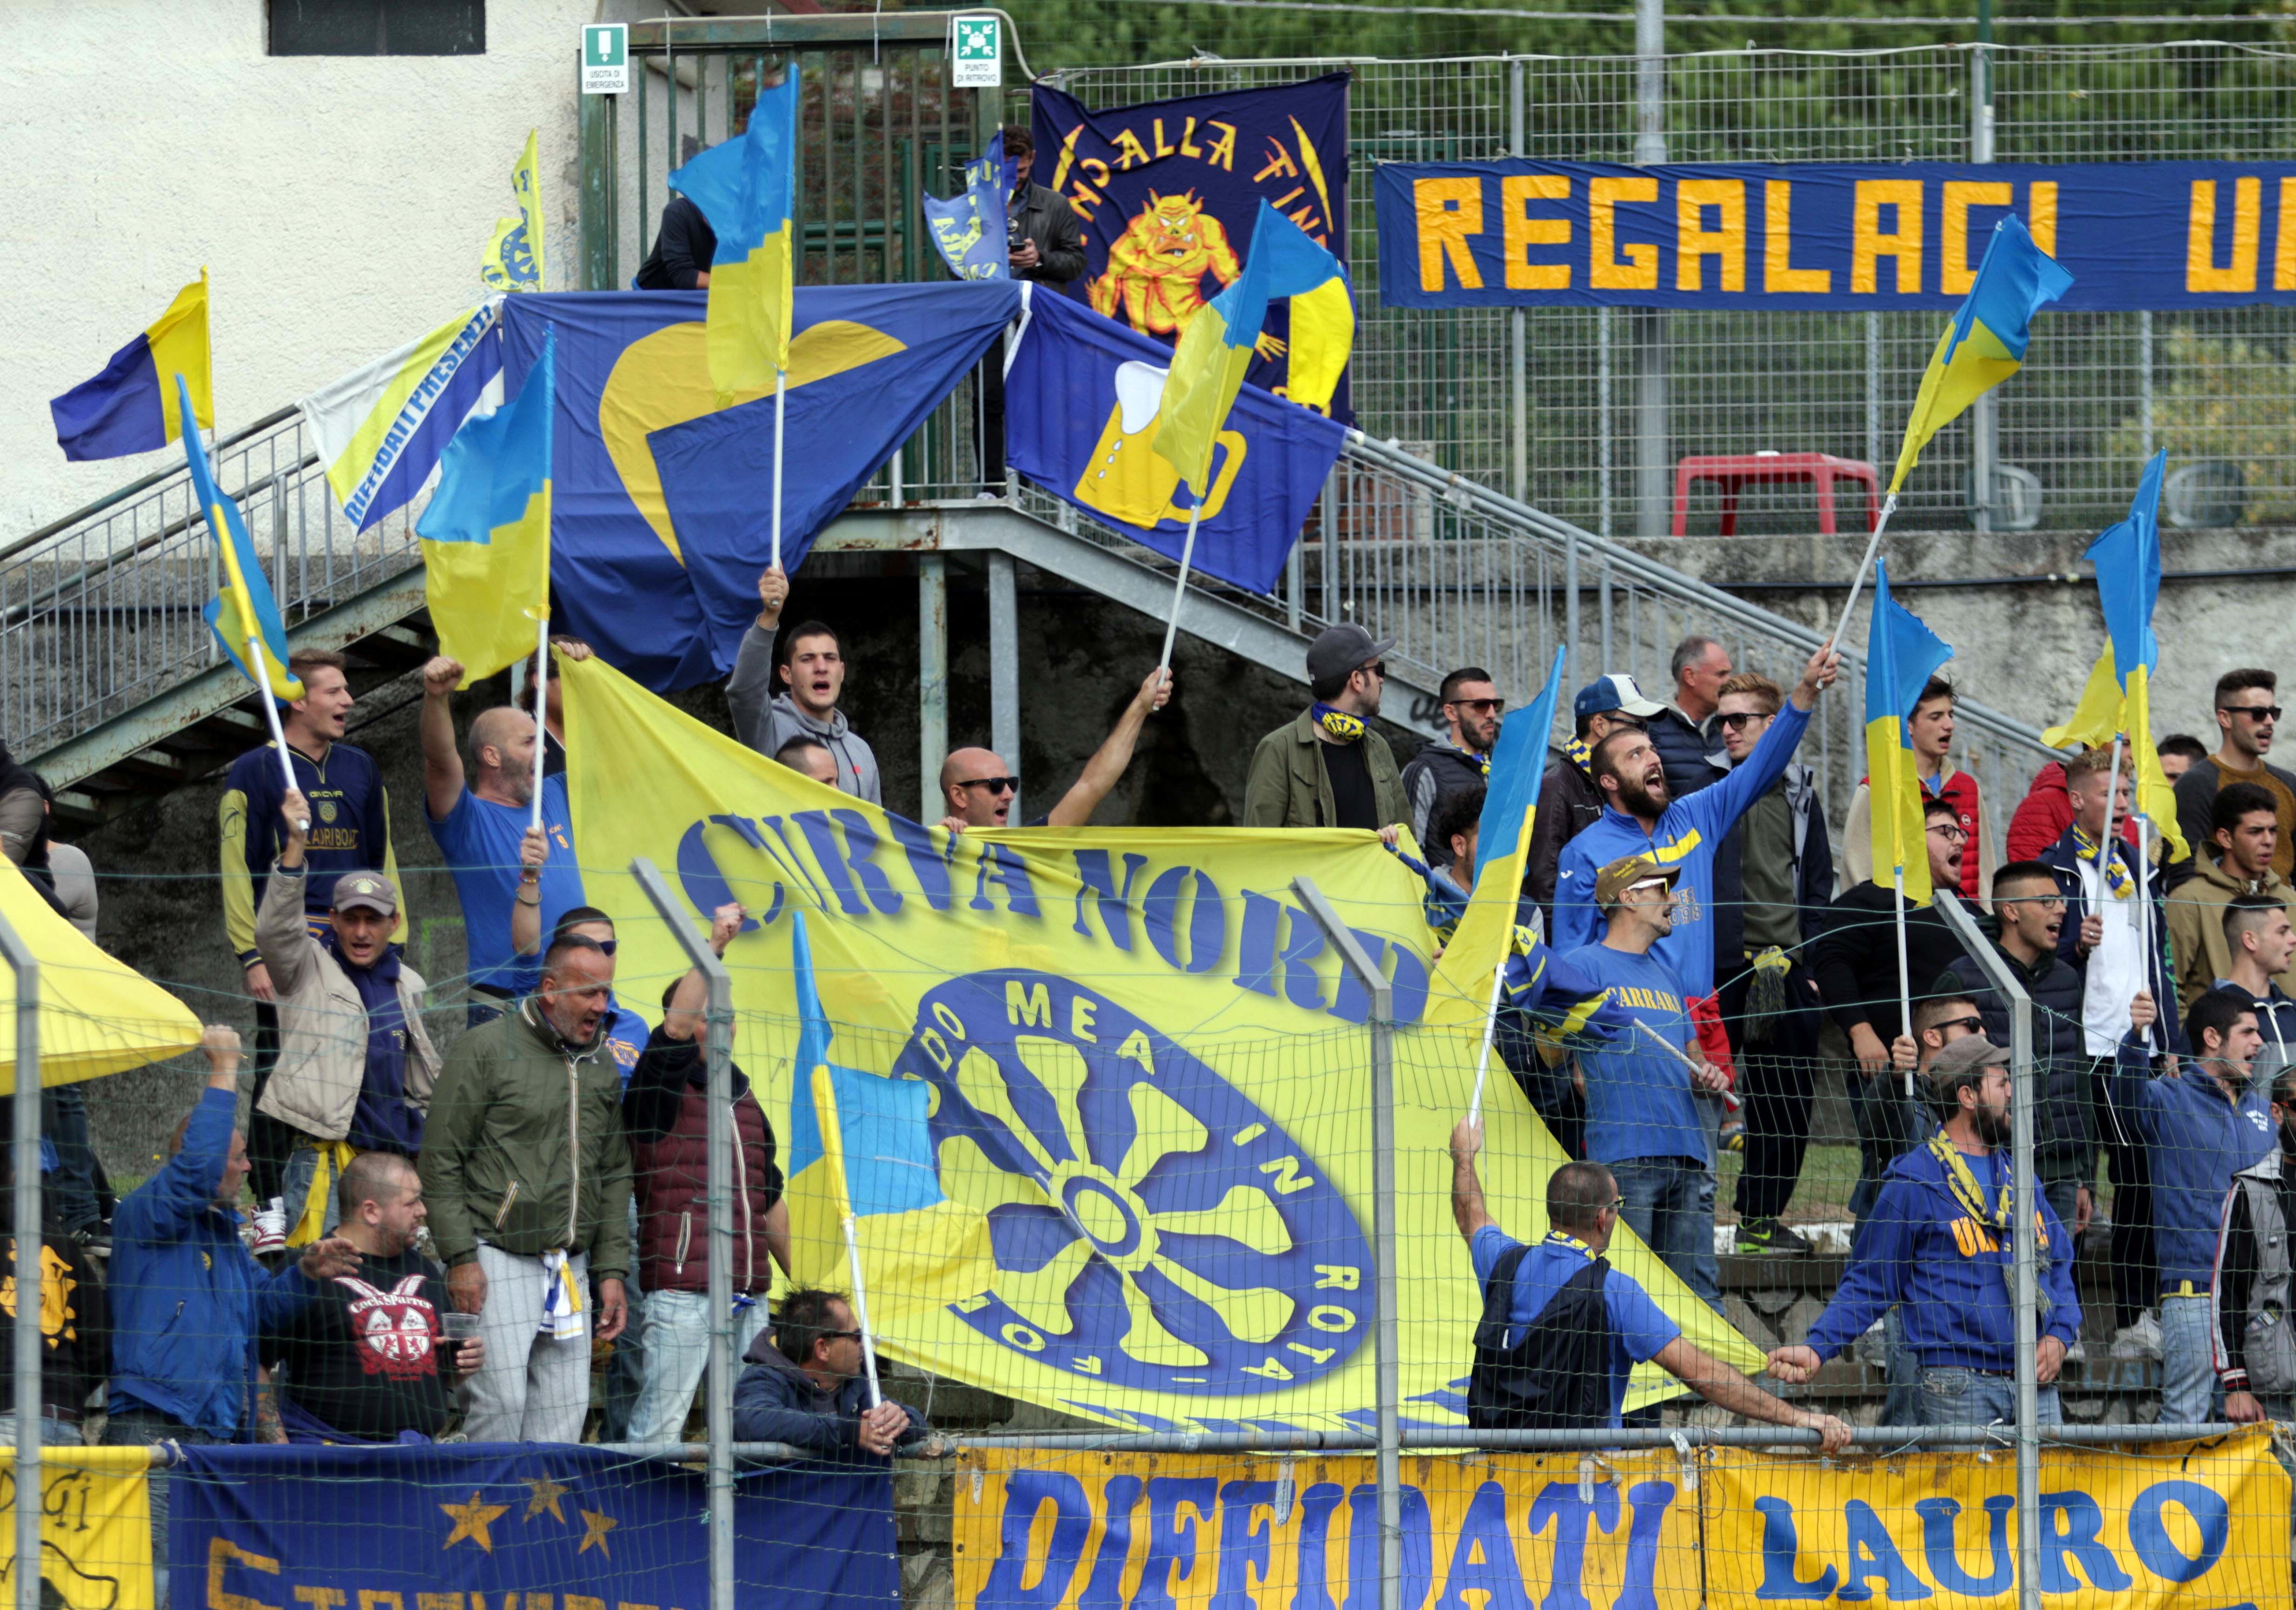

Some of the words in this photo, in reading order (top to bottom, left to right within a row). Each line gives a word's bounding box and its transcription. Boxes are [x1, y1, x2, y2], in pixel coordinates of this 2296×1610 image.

[1110, 116, 1236, 172] ALLA
[1253, 135, 1328, 249] FIN
[1413, 174, 2058, 295] REGALACI
[677, 808, 1042, 932] CURVA
[1072, 849, 1431, 1027] NORD
[1005, 980, 1155, 1076] MEA
[1605, 985, 1684, 1017] CARRARA
[1232, 1122, 1315, 1195] IN
[1240, 1263, 1360, 1382] ROTA
[975, 1469, 1675, 1610] DIFFIDATI
[1753, 1479, 2228, 1601] LAURO
